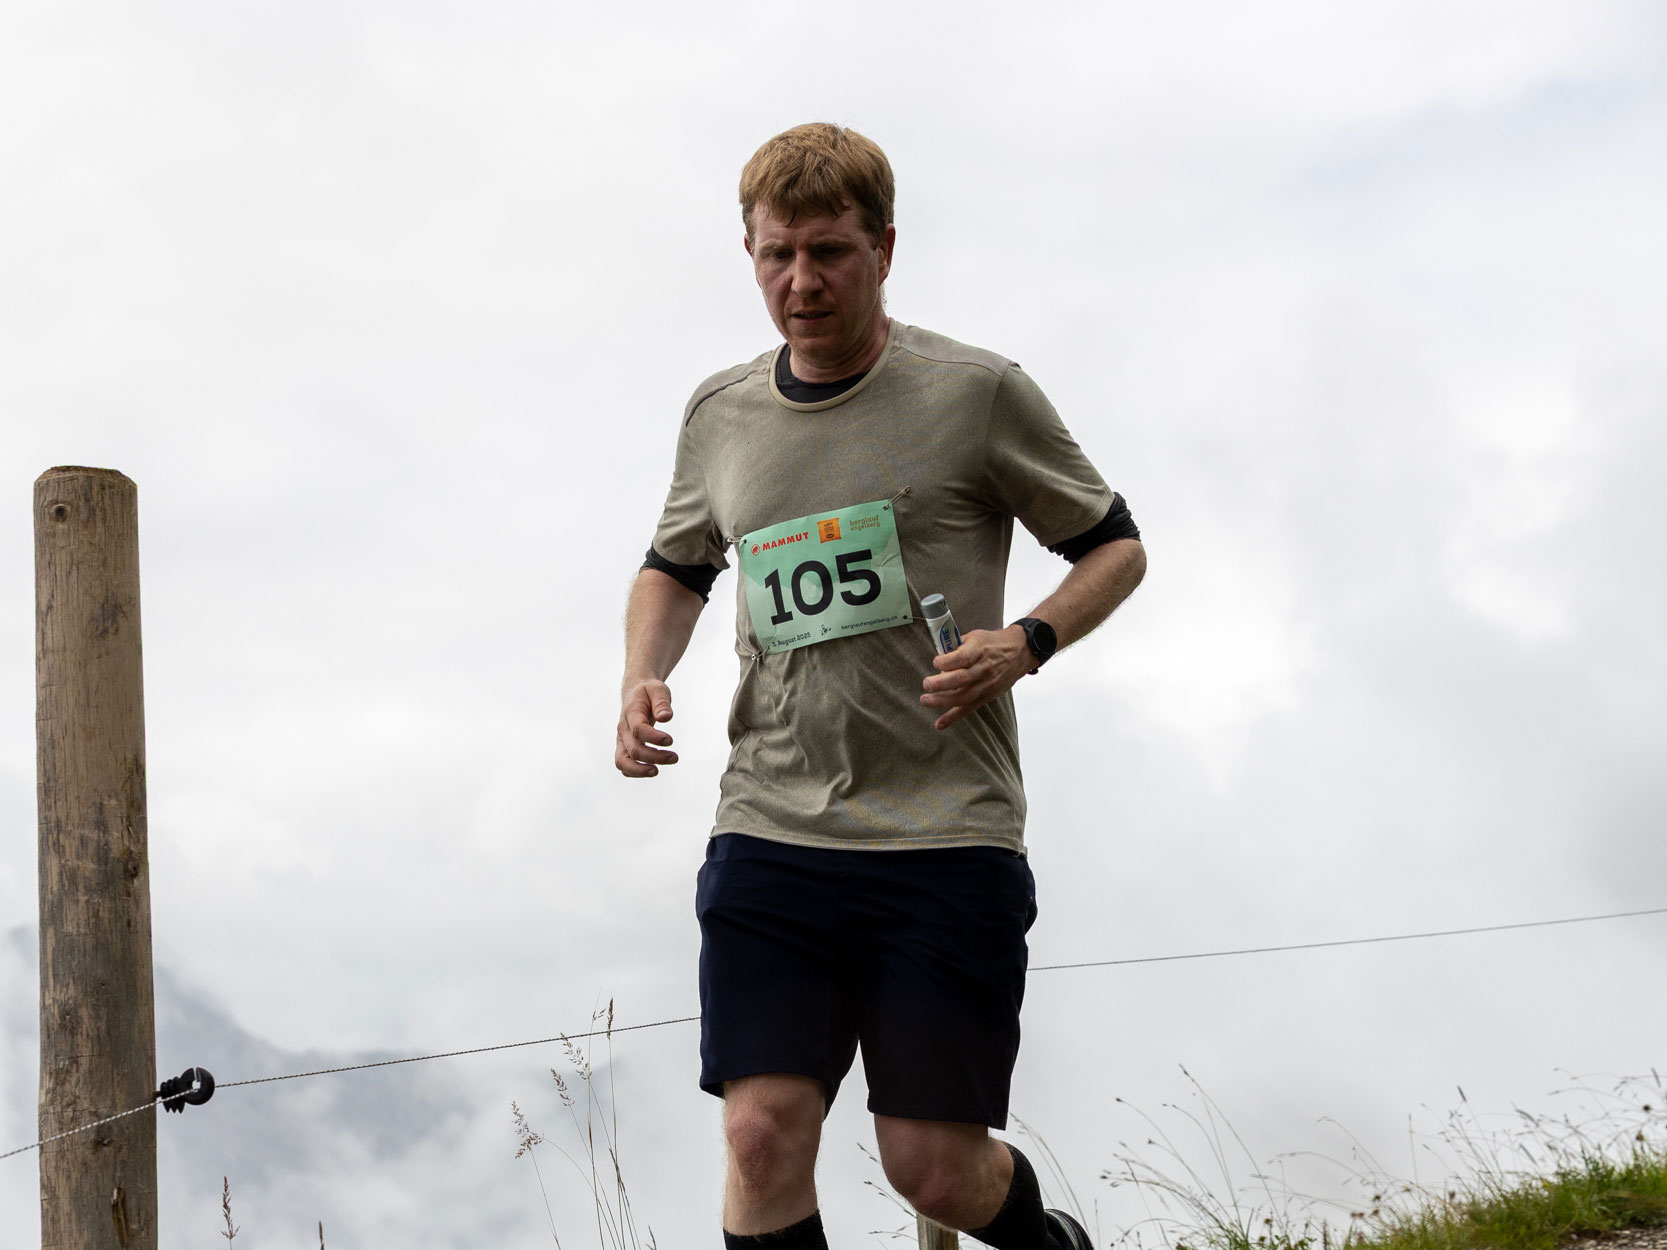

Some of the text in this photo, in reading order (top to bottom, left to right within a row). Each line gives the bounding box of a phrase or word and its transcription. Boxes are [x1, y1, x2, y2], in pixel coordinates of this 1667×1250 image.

[762, 531, 809, 551] MAMMUT
[764, 549, 881, 626] 105
[778, 637, 797, 646] August
[797, 632, 811, 641] 2025
[943, 628, 954, 651] PURE
